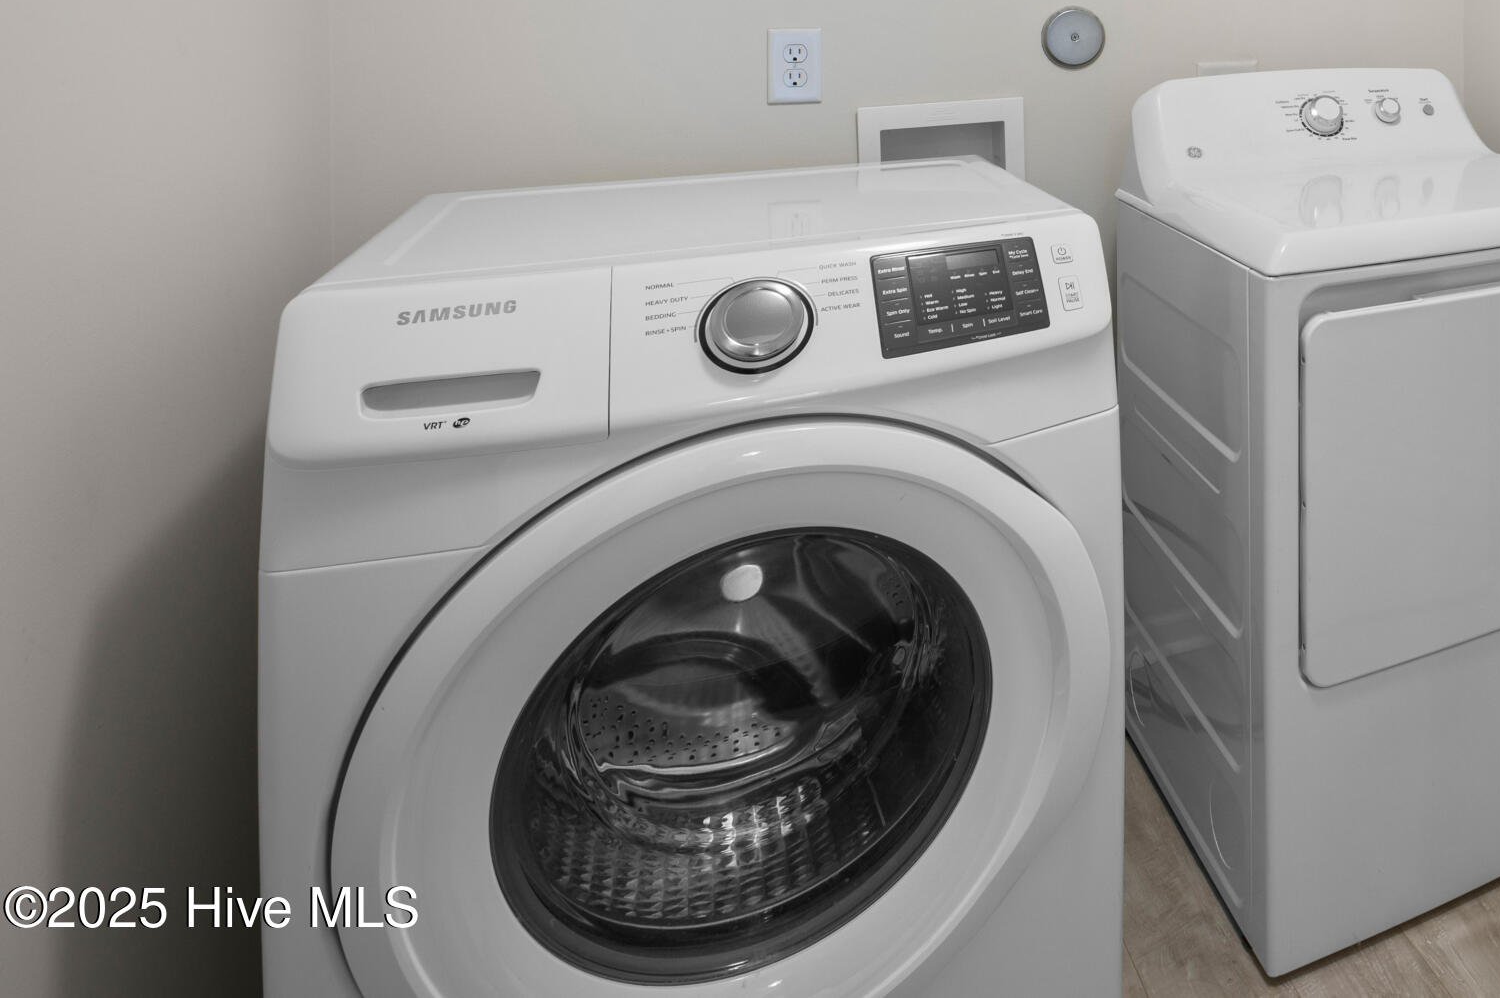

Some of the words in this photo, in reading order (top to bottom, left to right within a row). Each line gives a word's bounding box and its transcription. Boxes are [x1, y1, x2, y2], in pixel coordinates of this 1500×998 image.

[645, 282, 674, 290] NORMAL
[396, 299, 517, 326] SAMSUNG
[645, 312, 677, 321] BEDDING
